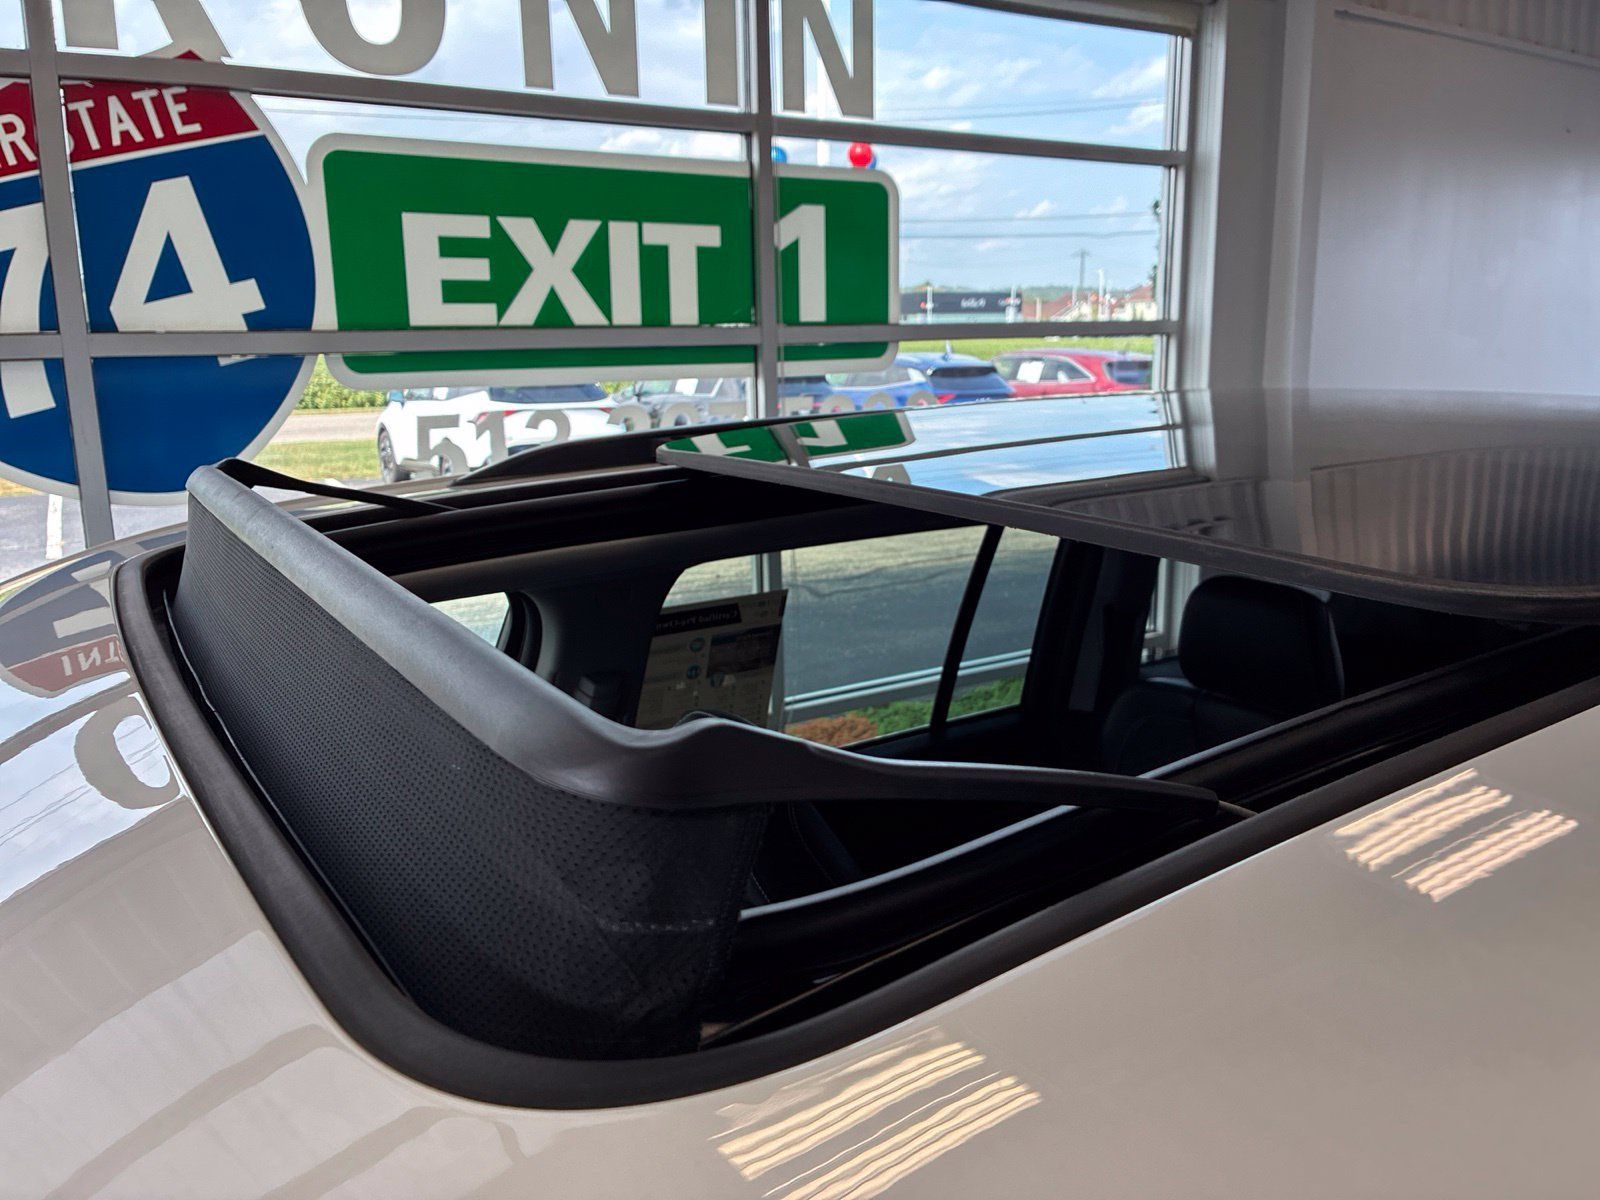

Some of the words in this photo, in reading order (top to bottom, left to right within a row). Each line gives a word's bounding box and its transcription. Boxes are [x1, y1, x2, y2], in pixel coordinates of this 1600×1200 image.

[62, 0, 876, 119] NIN
[0, 86, 202, 167] RTATE
[0, 176, 266, 419] 74
[401, 212, 721, 327] EXIT
[775, 204, 826, 323] 1
